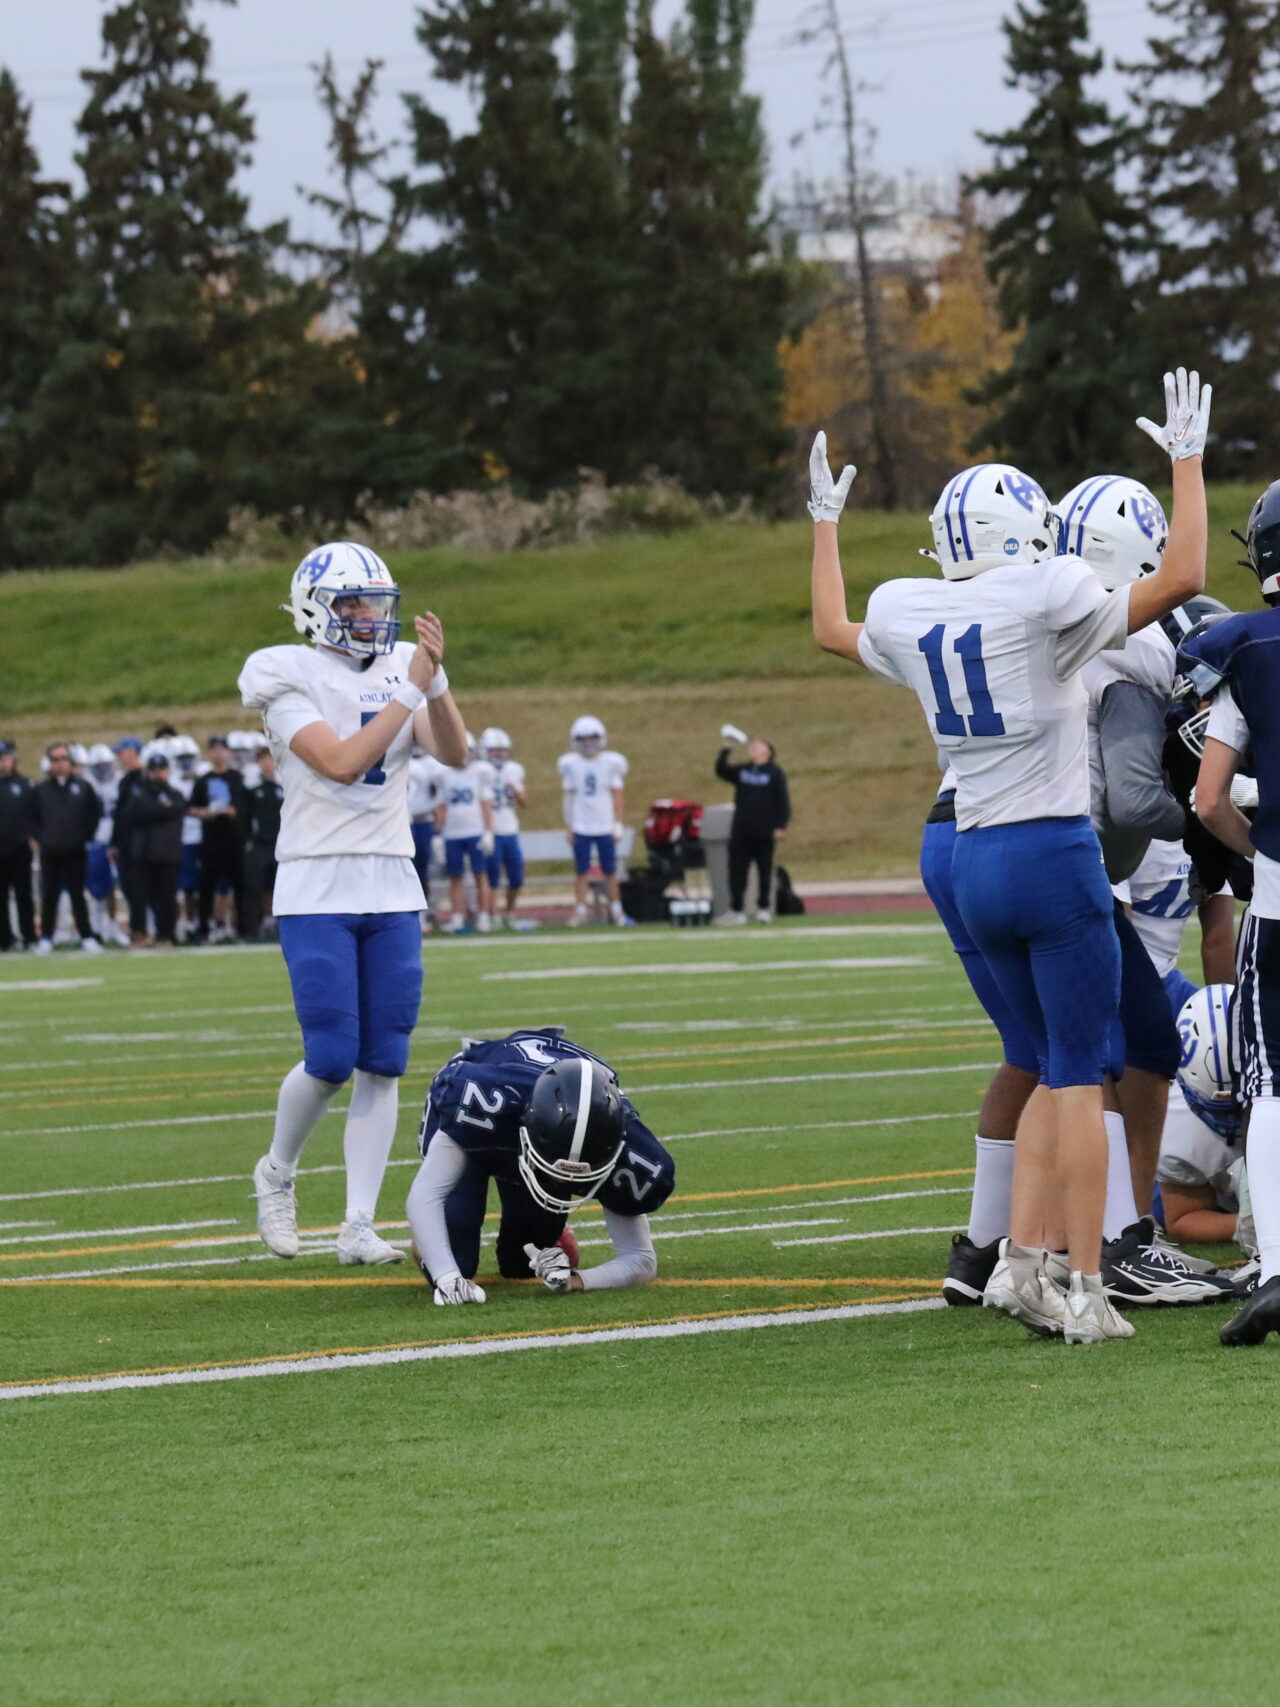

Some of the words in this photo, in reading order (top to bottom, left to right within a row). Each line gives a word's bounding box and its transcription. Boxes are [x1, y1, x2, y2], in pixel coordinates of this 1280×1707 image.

[917, 623, 1006, 737] 11
[455, 1080, 505, 1131] 21
[612, 1150, 662, 1202] 21
